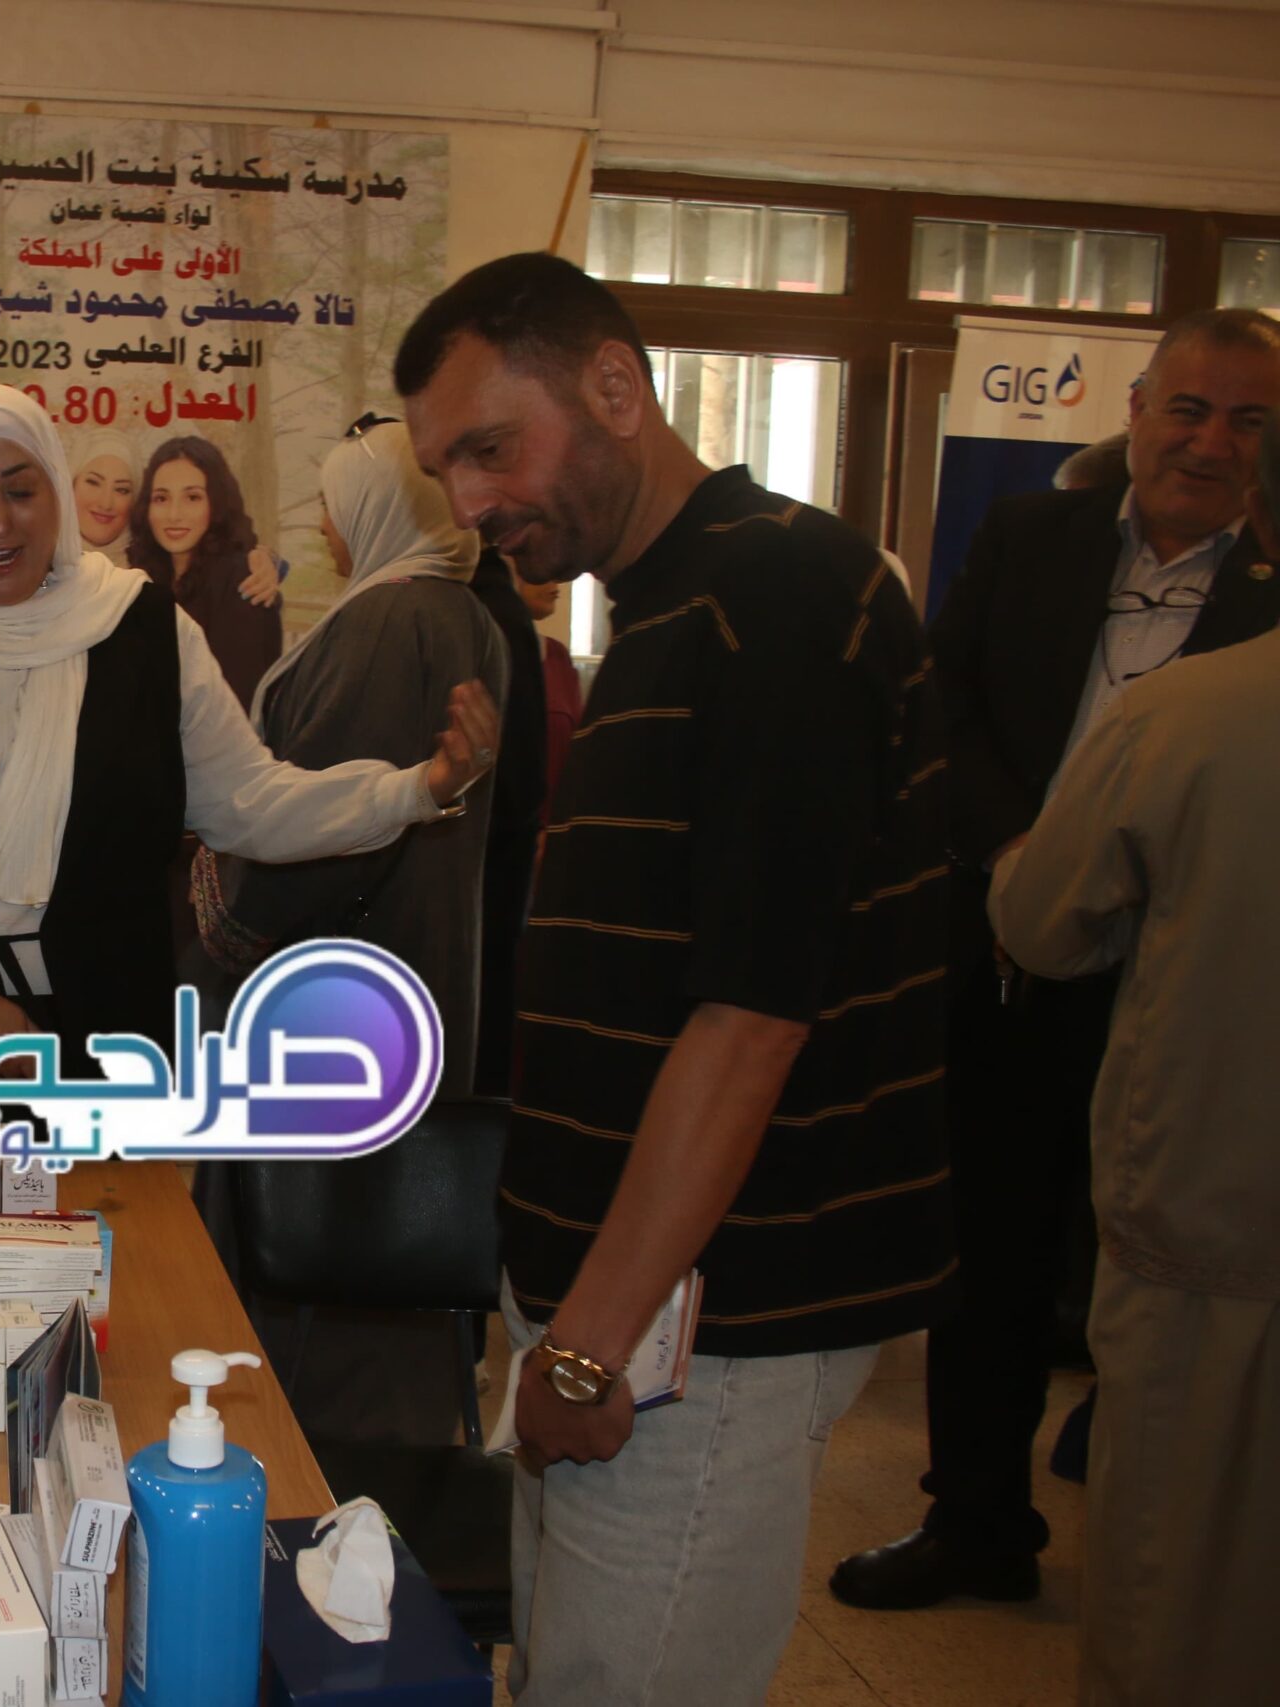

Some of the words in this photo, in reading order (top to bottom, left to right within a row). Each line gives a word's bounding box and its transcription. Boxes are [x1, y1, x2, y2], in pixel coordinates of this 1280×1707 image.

[107, 154, 177, 194] بنت
[189, 157, 291, 193] سكينة
[300, 161, 407, 204] مدرسة
[49, 199, 102, 225] عمان
[109, 200, 168, 225] قصبة
[174, 203, 213, 228] لواء
[16, 237, 102, 270] المملكة
[111, 245, 165, 277] على
[174, 246, 242, 281] الأولى
[65, 287, 169, 323] محمود
[180, 289, 301, 327] مصطفى
[313, 293, 355, 326] تالا
[83, 336, 186, 377] العلمي
[196, 340, 263, 373] الفرع
[982, 364, 1049, 406] GIG
[131, 381, 257, 427] المعدل:
